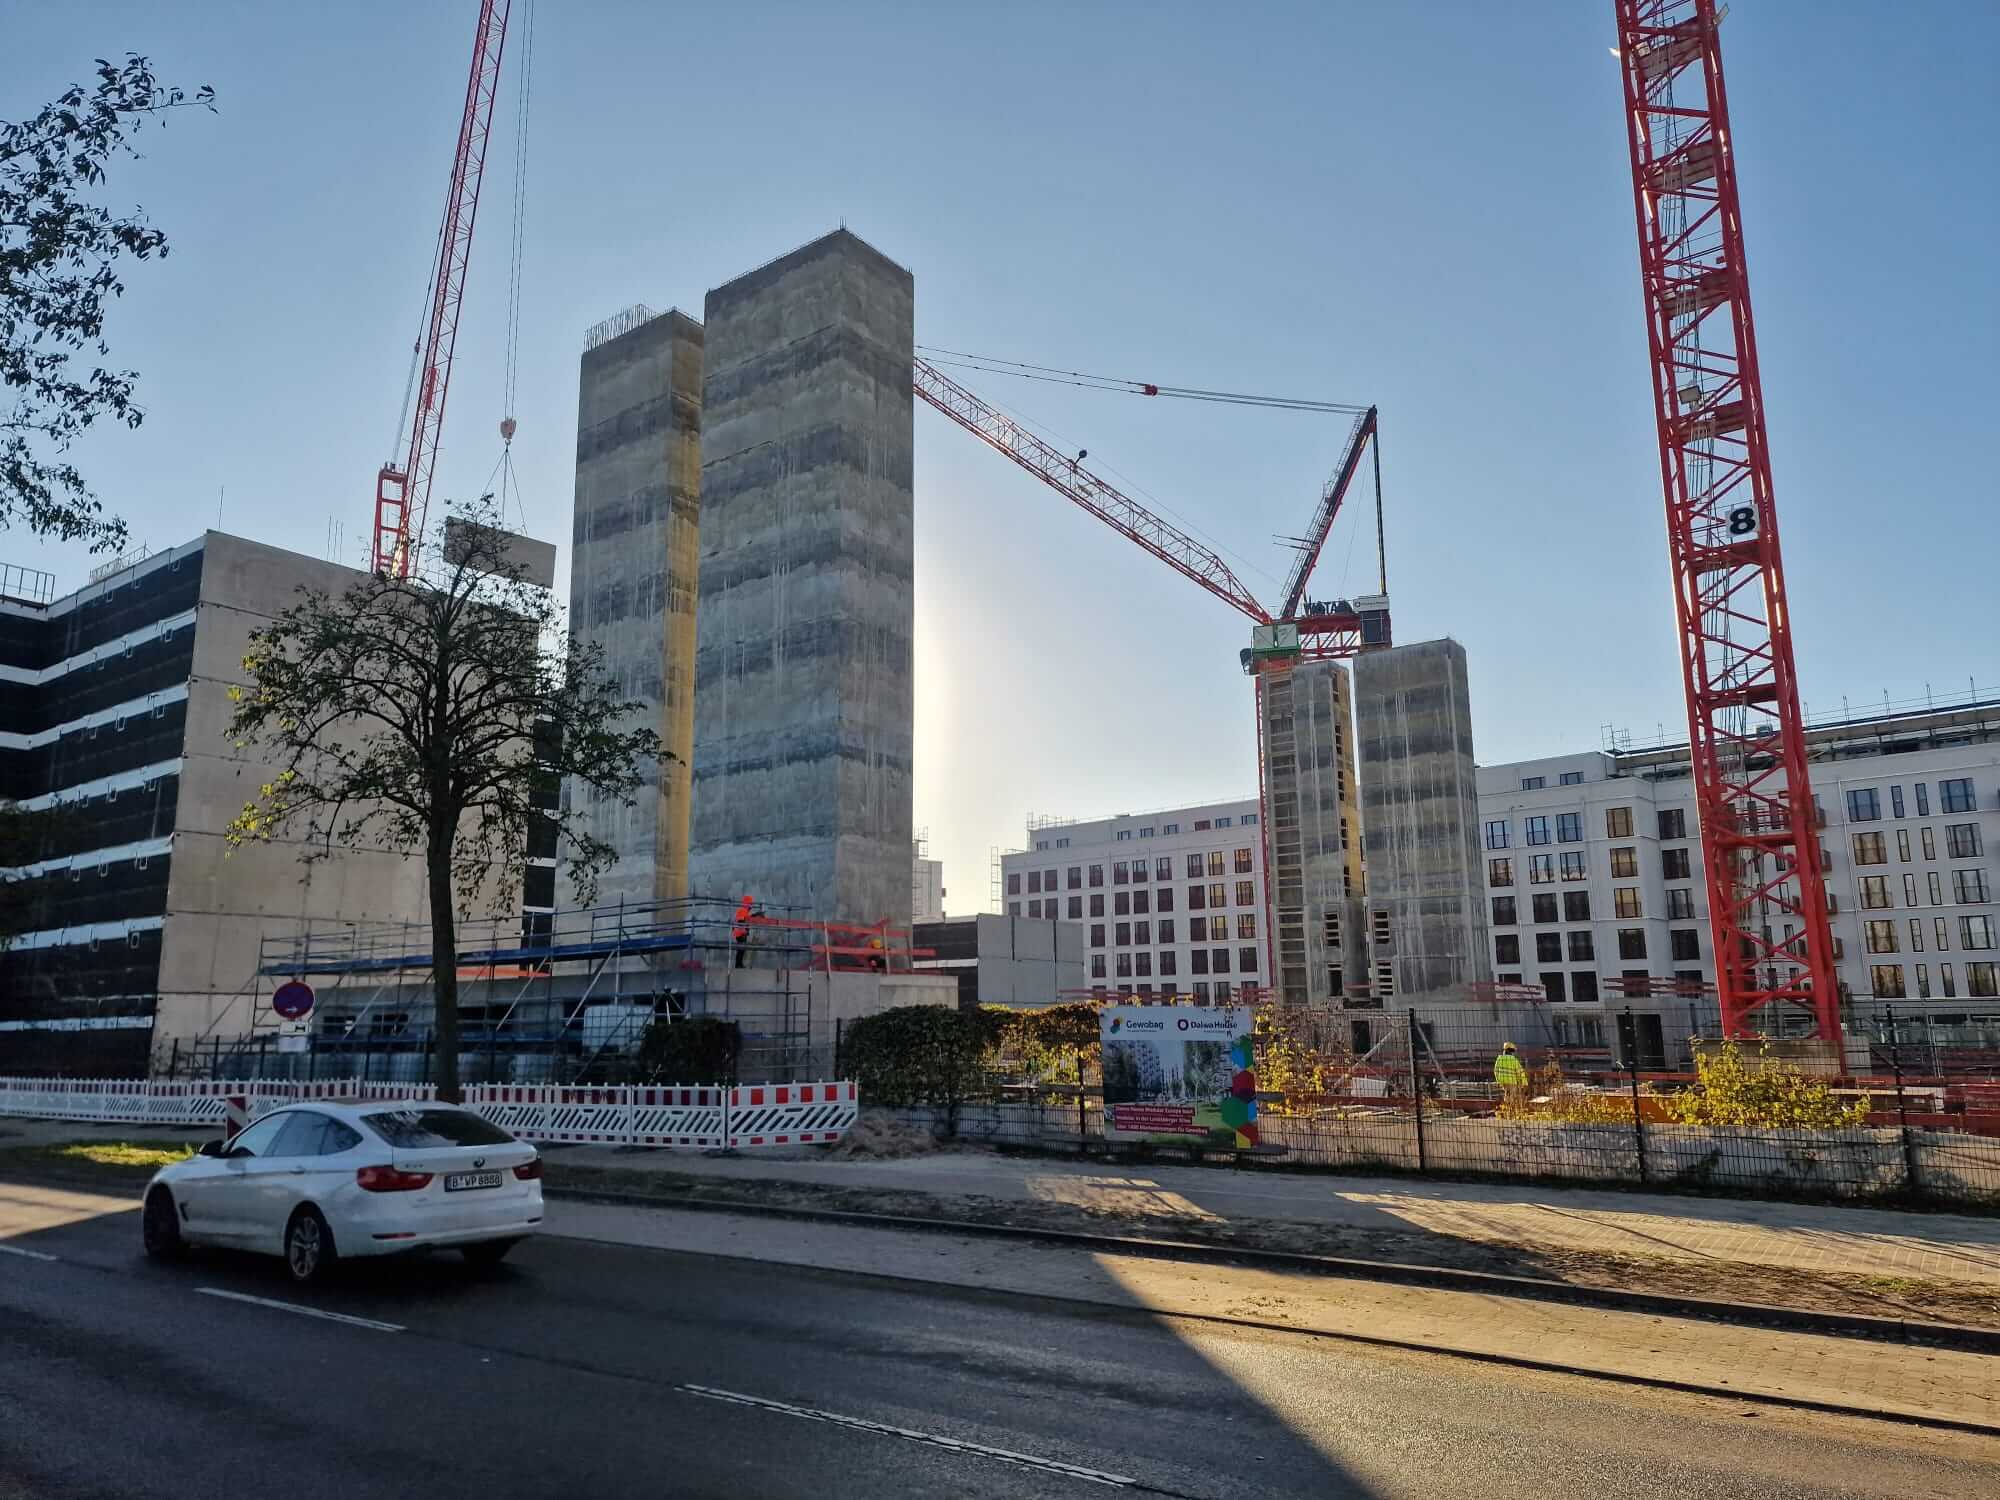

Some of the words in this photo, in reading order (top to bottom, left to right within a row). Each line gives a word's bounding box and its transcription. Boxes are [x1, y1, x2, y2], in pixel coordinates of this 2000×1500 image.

[1730, 507, 1756, 535] 8
[1126, 1019, 1164, 1030] Gewobag
[1190, 1020, 1213, 1029] Daiwa
[452, 1176, 458, 1187] B
